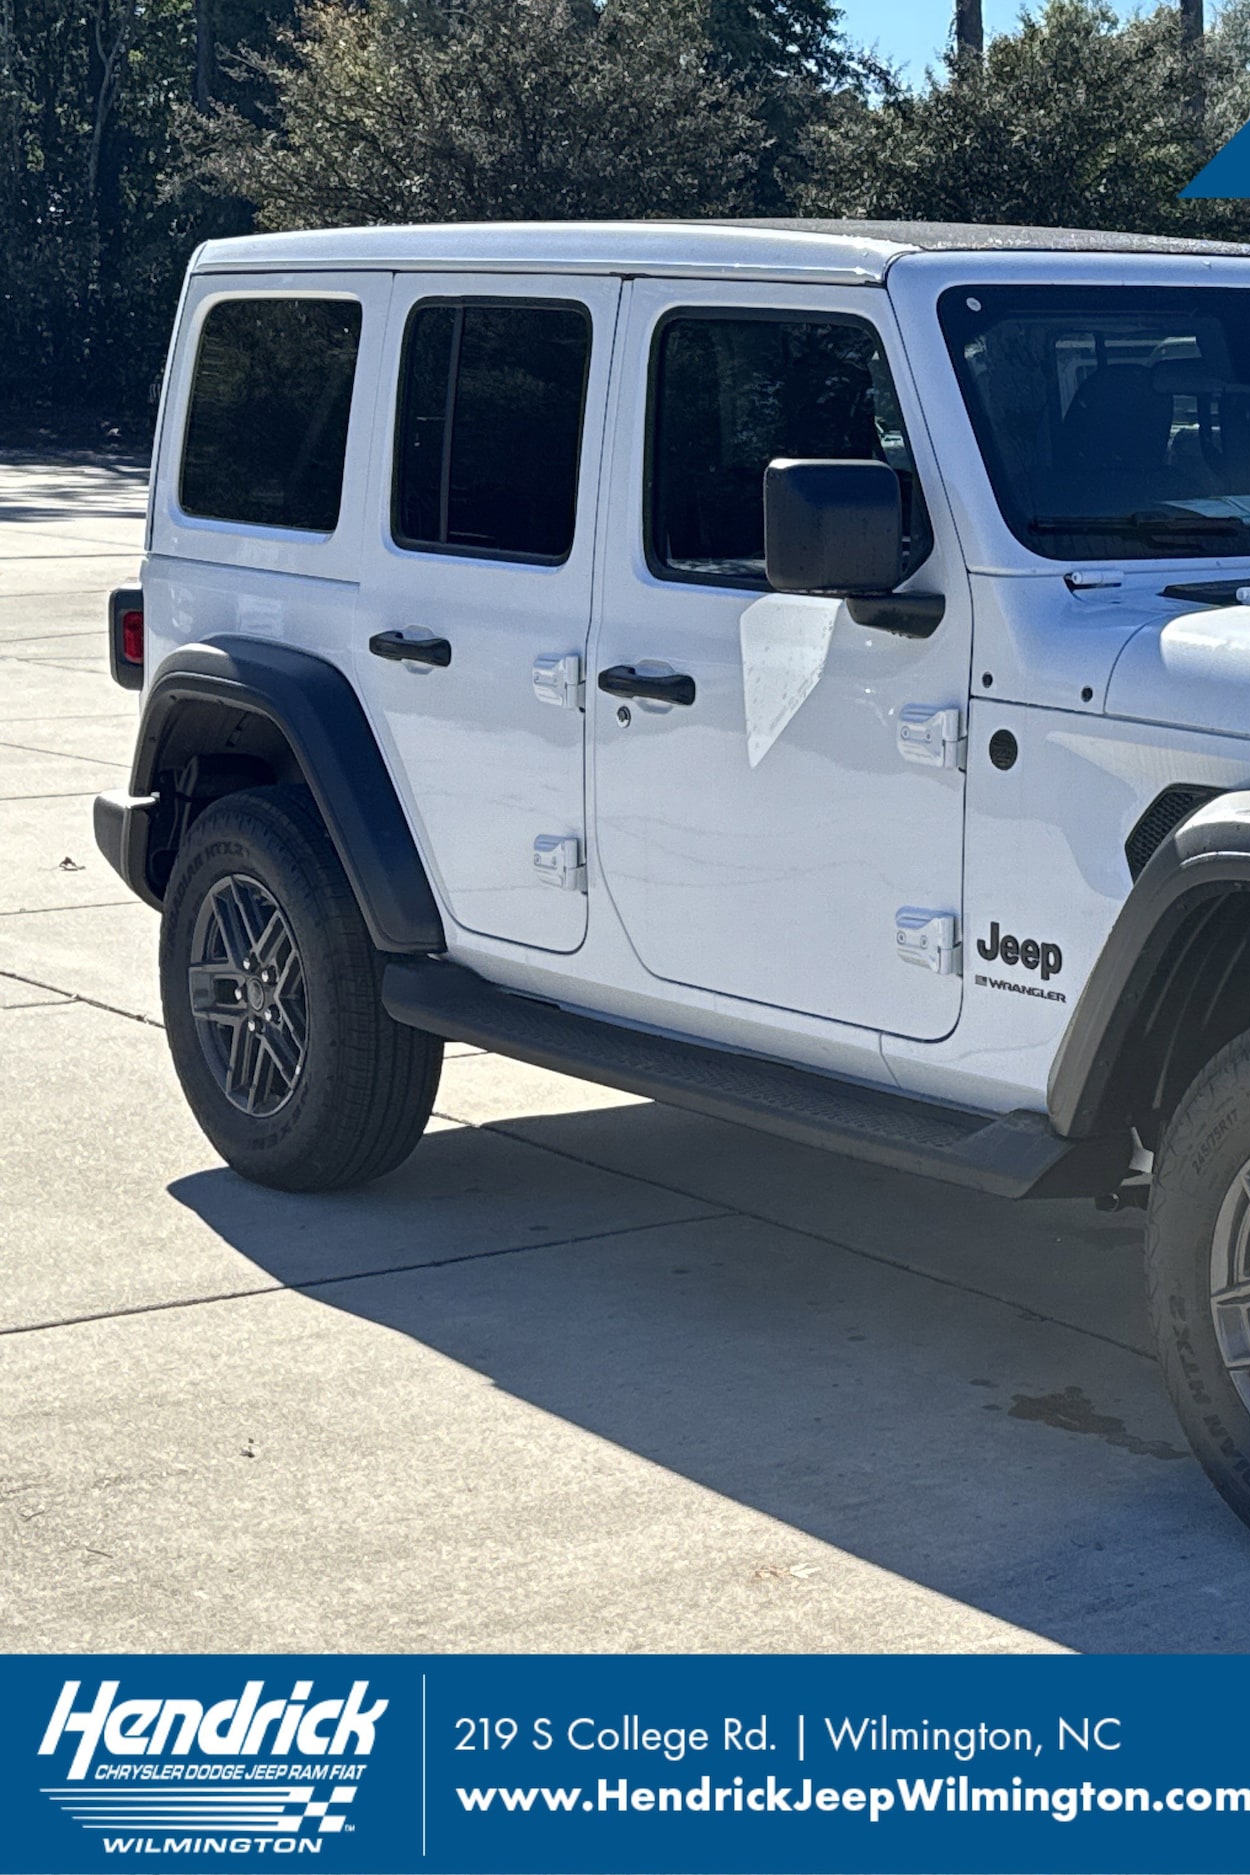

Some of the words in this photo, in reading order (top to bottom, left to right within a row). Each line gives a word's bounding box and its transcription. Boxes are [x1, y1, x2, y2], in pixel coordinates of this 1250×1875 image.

[976, 921, 1063, 981] Jeep
[989, 978, 1067, 1004] WRANGLER
[1191, 1107, 1239, 1176] 245/75R17
